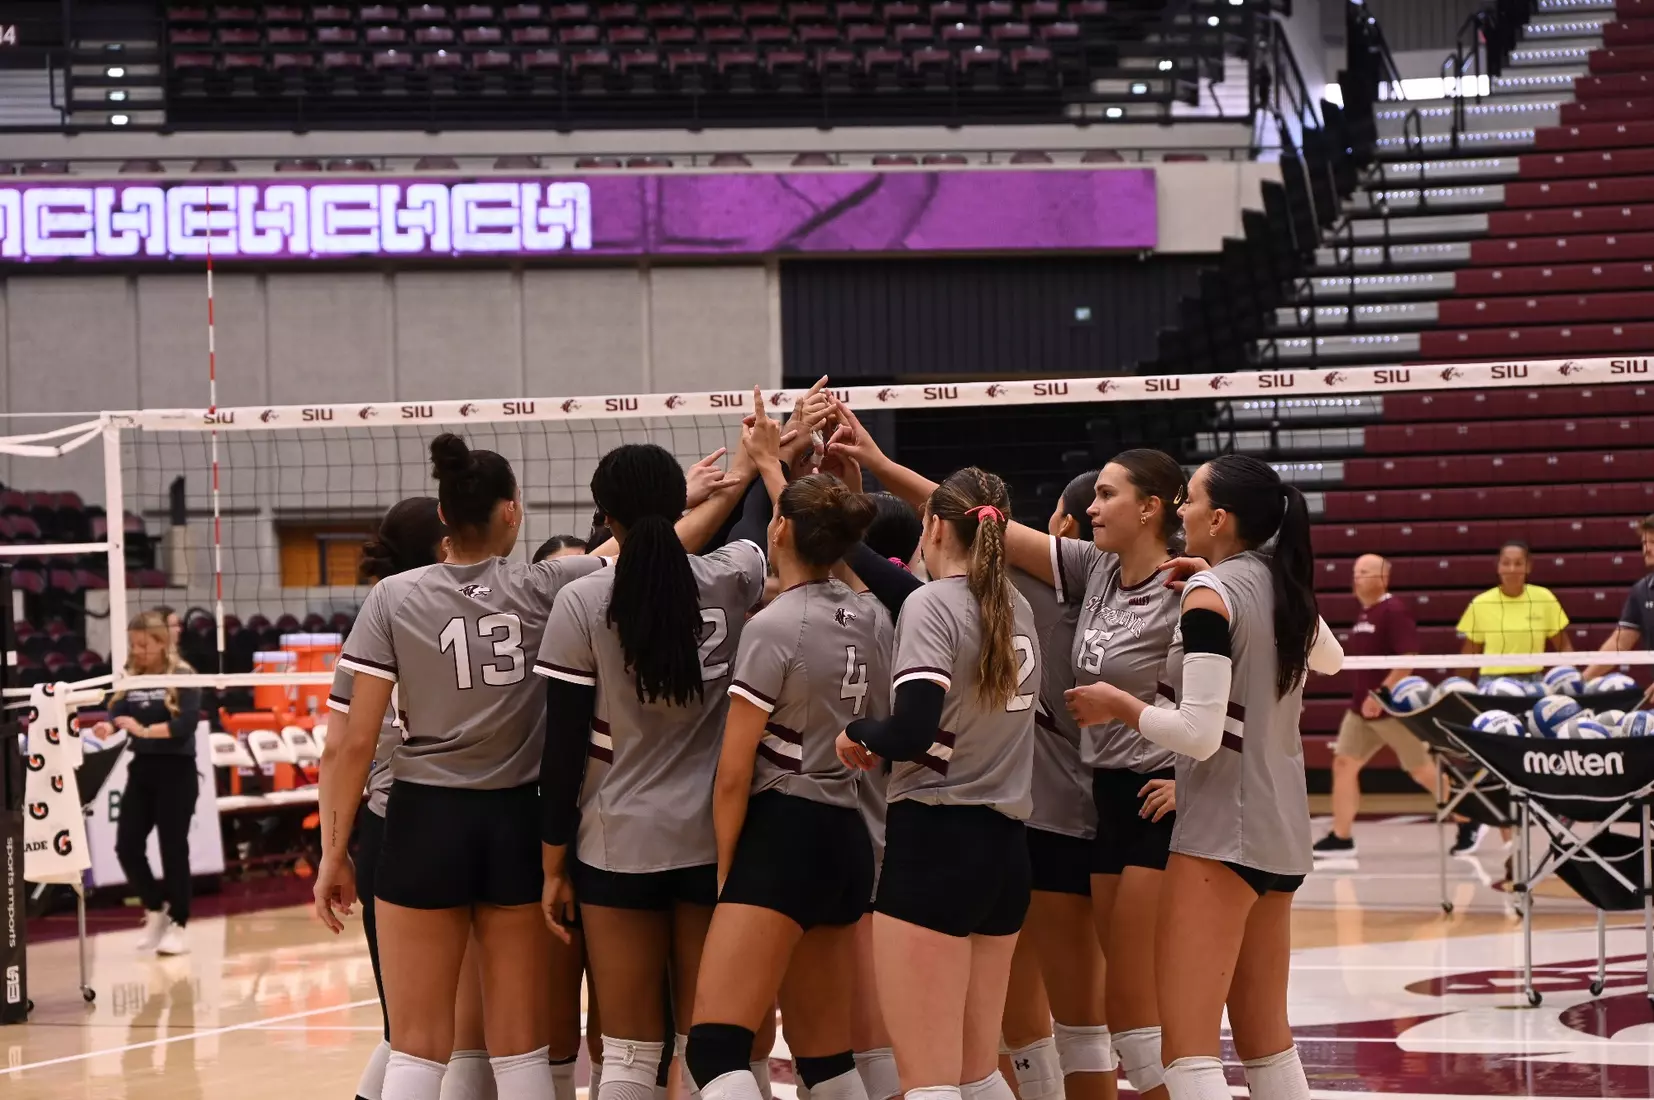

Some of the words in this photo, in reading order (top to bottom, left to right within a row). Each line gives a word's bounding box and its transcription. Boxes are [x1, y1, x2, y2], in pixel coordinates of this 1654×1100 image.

[1491, 365, 1528, 379] SIU
[1610, 359, 1648, 374] SIU
[1258, 374, 1294, 388] SIU
[1374, 369, 1411, 384] SIU
[1033, 382, 1068, 396] SIU
[1145, 378, 1181, 392] SIU
[923, 386, 958, 400] SIU
[503, 401, 535, 415] SIU
[605, 398, 638, 412] SIU
[710, 394, 743, 408] SIU
[203, 411, 235, 425] SIU
[302, 408, 334, 421] SIU
[401, 405, 433, 418] SIU
[438, 611, 527, 691] 13
[1076, 628, 1116, 676] 15
[839, 644, 870, 716] 4
[1523, 750, 1625, 777] molten
[24, 840, 49, 853] ADE
[53, 829, 73, 857] G
[6, 837, 15, 886] sports
[6, 887, 17, 948] imports
